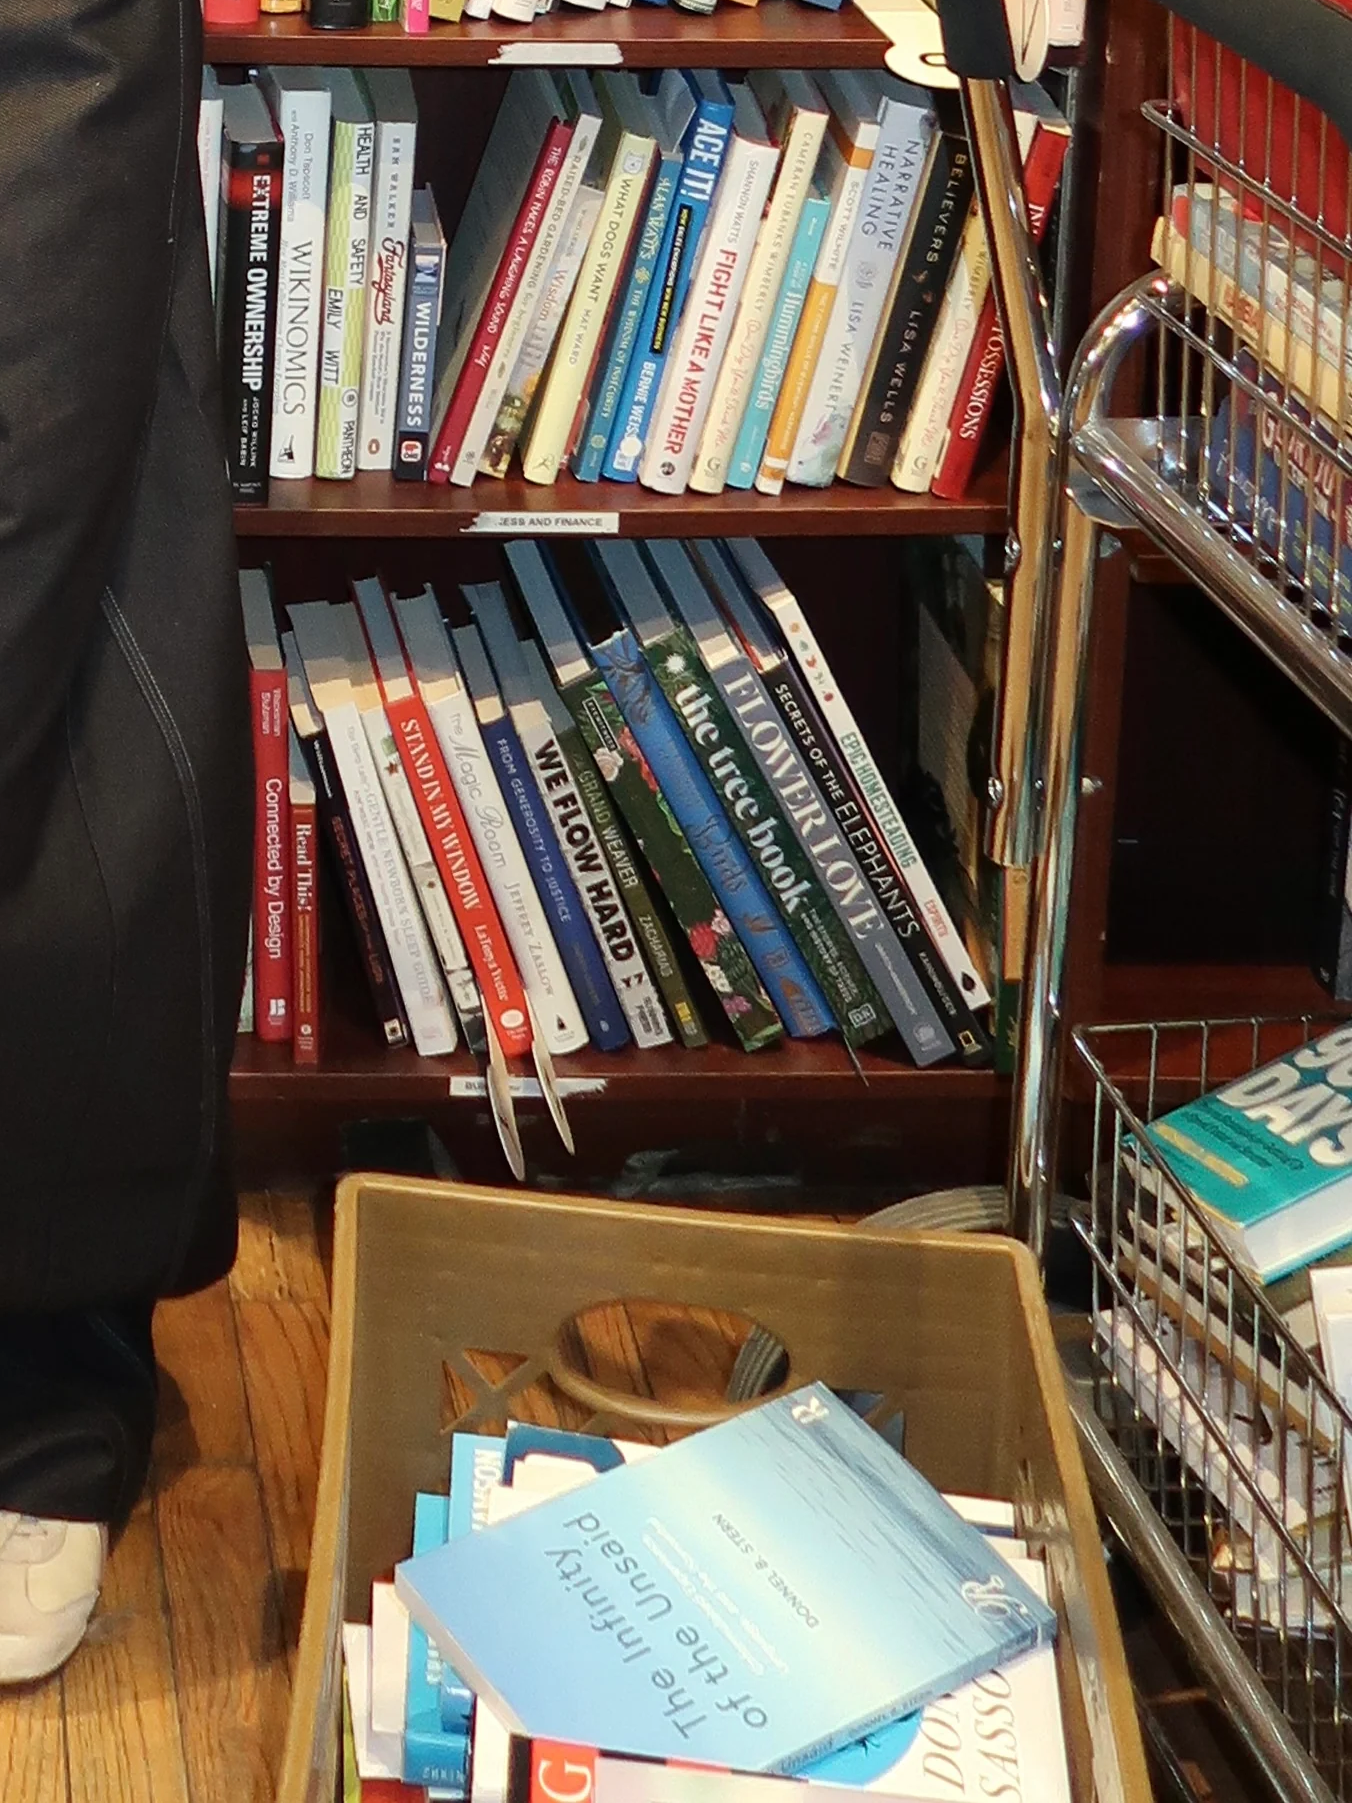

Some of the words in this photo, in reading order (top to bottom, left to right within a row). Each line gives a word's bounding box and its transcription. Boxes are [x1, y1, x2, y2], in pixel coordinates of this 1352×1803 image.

[356, 127, 370, 175] HEALTH
[249, 175, 270, 262] EXTREME
[353, 194, 367, 220] AND
[350, 239, 365, 286] SAFETY
[702, 248, 737, 311] FIGHT
[242, 268, 267, 390] OWNERSHIP
[283, 241, 313, 415] WIKINOMICS
[326, 288, 343, 329] EMILY
[691, 314, 718, 357] LIKE
[324, 350, 340, 385] WITT
[407, 302, 431, 426] WILDERNESS
[688, 361, 704, 373] A
[664, 377, 701, 455] MOTHER
[341, 421, 354, 474] PANTHEON
[527, 517, 552, 527] AND
[554, 517, 603, 527] FINANCE
[400, 719, 432, 776] STAND
[536, 738, 566, 790] WE
[420, 780, 438, 800] IN
[425, 803, 452, 830] MY
[676, 683, 731, 741] the
[708, 744, 755, 809] tree
[734, 814, 813, 915] book
[723, 674, 826, 836] FLOWER
[807, 839, 883, 941] LOVE
[263, 778, 283, 868] Connected
[548, 793, 601, 874] FLOW
[265, 873, 283, 892] by
[435, 833, 483, 910] WINDOW
[263, 898, 286, 959] Design
[578, 880, 634, 961] HARD
[712, 1513, 754, 1555] STERN
[754, 1554, 769, 1570] B.
[562, 1511, 673, 1621] Unsaid
[544, 1548, 652, 1664] Infinity
[767, 1570, 820, 1629] DONNEL
[676, 1625, 729, 1685] the
[651, 1667, 708, 1740] The
[715, 1694, 768, 1729] of
